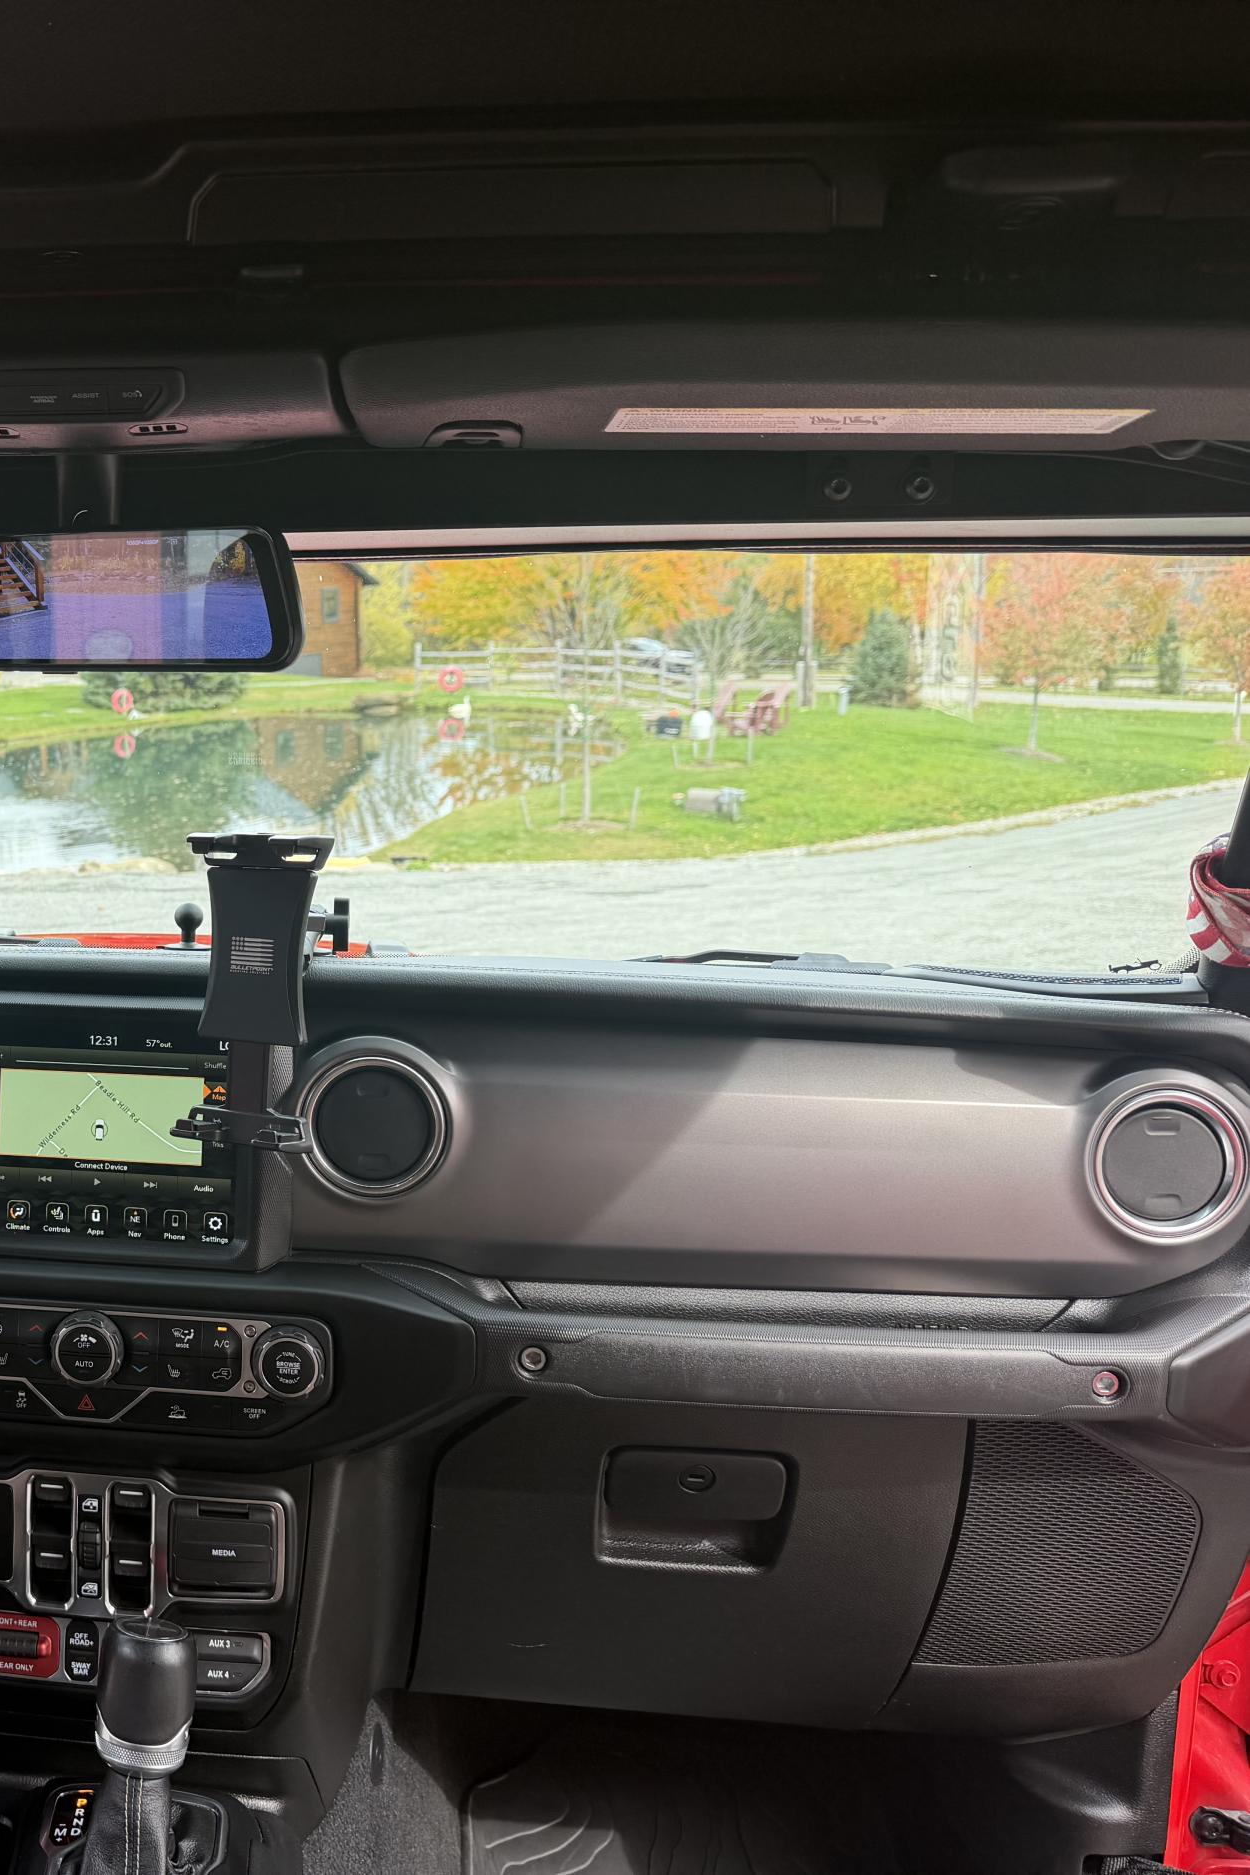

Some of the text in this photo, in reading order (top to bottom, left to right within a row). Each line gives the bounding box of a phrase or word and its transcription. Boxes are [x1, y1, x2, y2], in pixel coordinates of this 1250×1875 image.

[89, 1035, 118, 1047] 12:31
[204, 1062, 227, 1070] Shuffle
[95, 1080, 141, 1124] Beadle Hill Rd
[212, 1093, 227, 1102] Map
[38, 1115, 72, 1148] Wilderness
[70, 1104, 81, 1115] Rd
[74, 1161, 128, 1171] Connect Device
[193, 1184, 213, 1192] Audio
[130, 1215, 141, 1223] NE
[5, 1222, 31, 1231] Climate
[43, 1225, 71, 1233] Controls
[87, 1227, 105, 1236] Apps
[128, 1230, 142, 1238] Nav
[163, 1232, 186, 1241] Phone
[201, 1235, 229, 1244] Settings
[214, 1339, 230, 1348] A/C
[75, 1360, 94, 1368] AUTO
[212, 1549, 237, 1557] MEDIA
[74, 1632, 89, 1640] OFF
[209, 1639, 231, 1648] AUX 3
[15, 1663, 34, 1671] ONLY
[71, 1661, 91, 1669] SWAY
[73, 1667, 89, 1675] BAR
[207, 1670, 230, 1679] AUX 4
[77, 1798, 88, 1807] P
[75, 1808, 85, 1817] R
[72, 1818, 84, 1826] N
[54, 1828, 67, 1836] M
[70, 1827, 81, 1836] D
